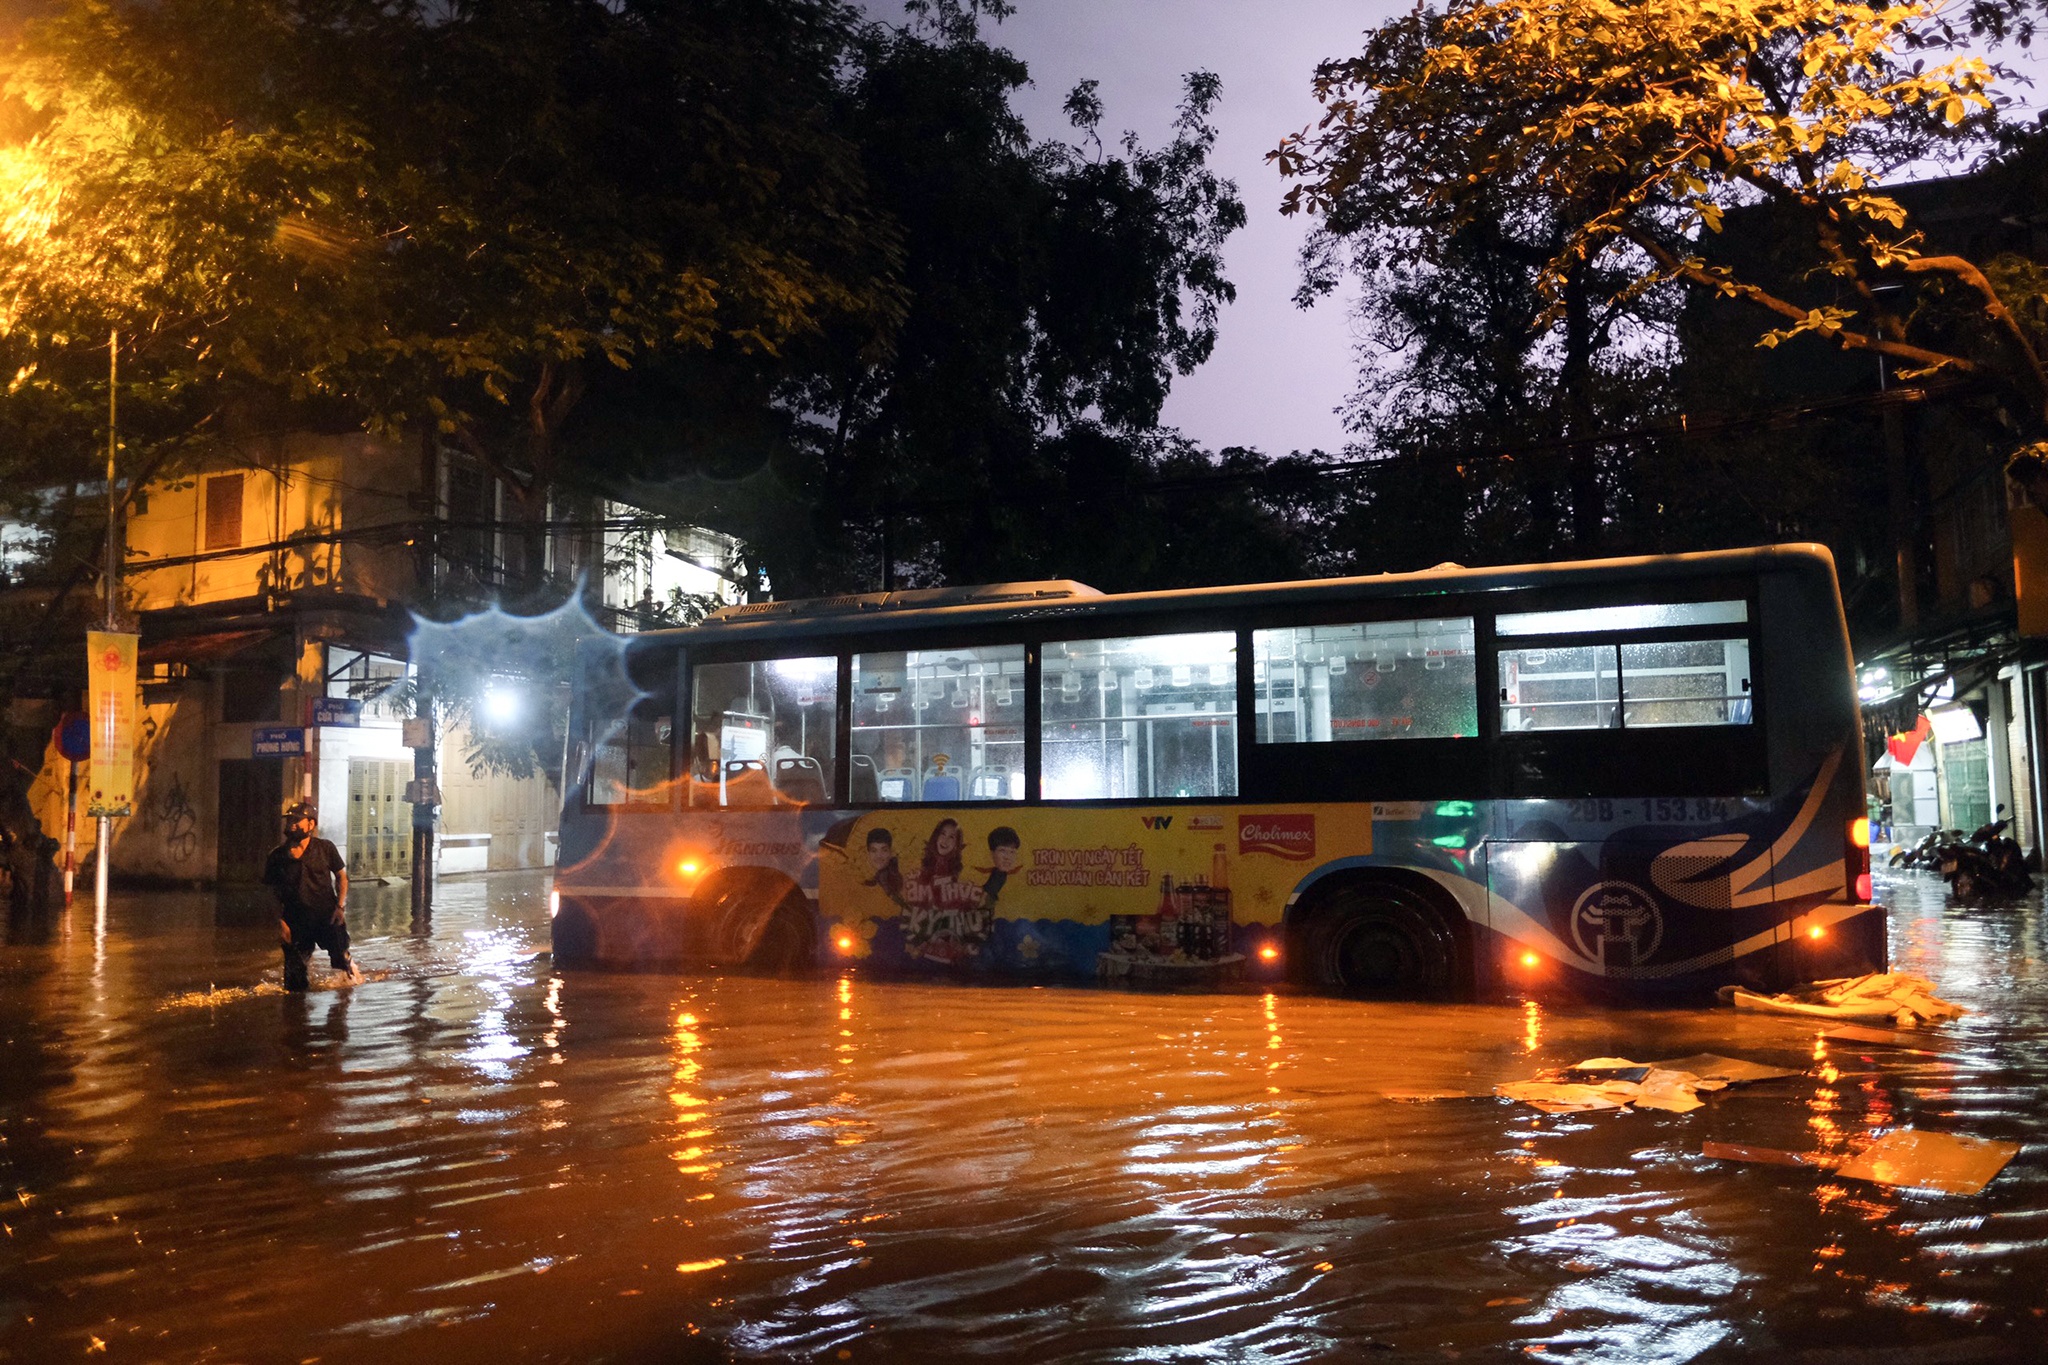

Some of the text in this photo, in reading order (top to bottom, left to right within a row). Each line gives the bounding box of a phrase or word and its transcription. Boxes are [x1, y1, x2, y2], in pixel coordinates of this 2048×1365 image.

[1569, 799, 1614, 823] 29B
[1640, 798, 1729, 823] 153.84
[1142, 815, 1174, 831] VTV
[1240, 824, 1313, 842] Cholimex
[1033, 848, 1066, 867] TRỌN
[1084, 845, 1118, 866] NGÀY
[1120, 842, 1144, 866] TẾT
[1058, 866, 1093, 888] XUÂN
[1125, 865, 1150, 888] KẾT
